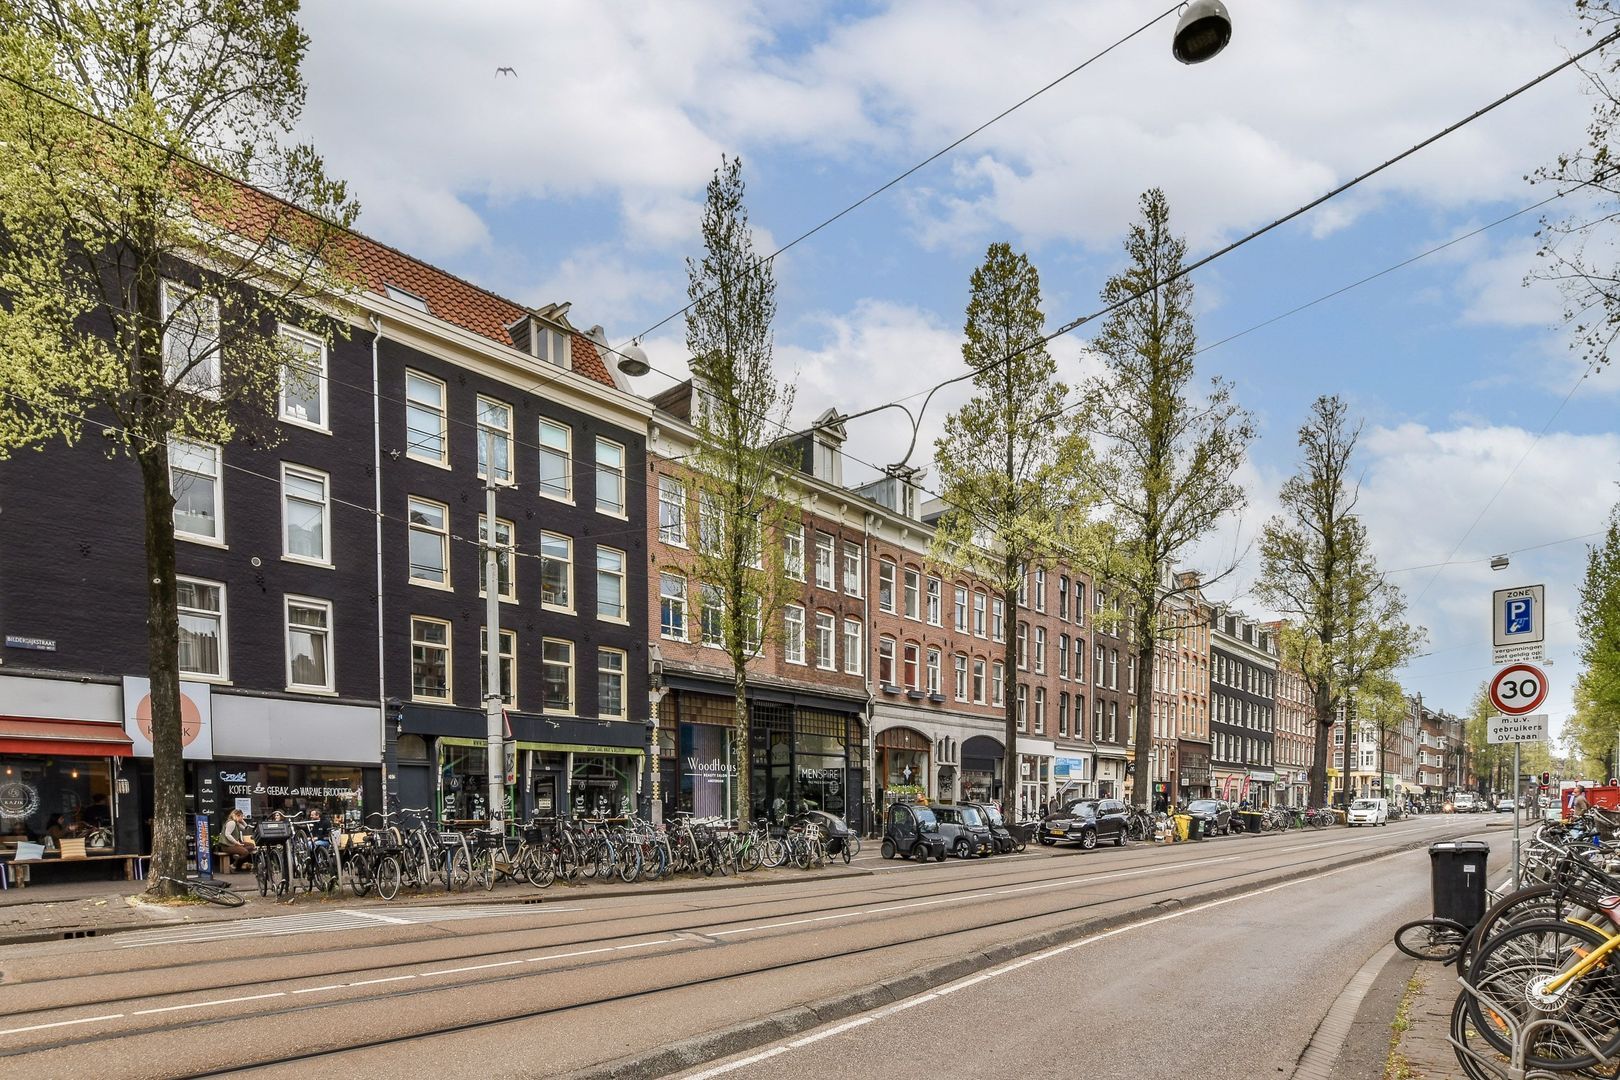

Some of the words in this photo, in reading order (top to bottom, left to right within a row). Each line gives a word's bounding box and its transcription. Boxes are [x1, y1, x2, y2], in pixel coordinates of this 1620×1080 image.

[1506, 589, 1530, 598] ZONE
[1511, 601, 1526, 620] P
[7, 636, 56, 646] BILDERDIJKSTRAAT
[1494, 645, 1543, 653] vergunningen
[1501, 679, 1537, 699] 30
[1493, 724, 1543, 734] gebruikers
[1497, 733, 1537, 741] OV-baan
[687, 756, 737, 772] WoodHous
[801, 768, 838, 780] MENSPIRE
[228, 785, 252, 795] KOFFIE
[266, 786, 290, 796] GEBAK
[300, 787, 322, 797] WARME
